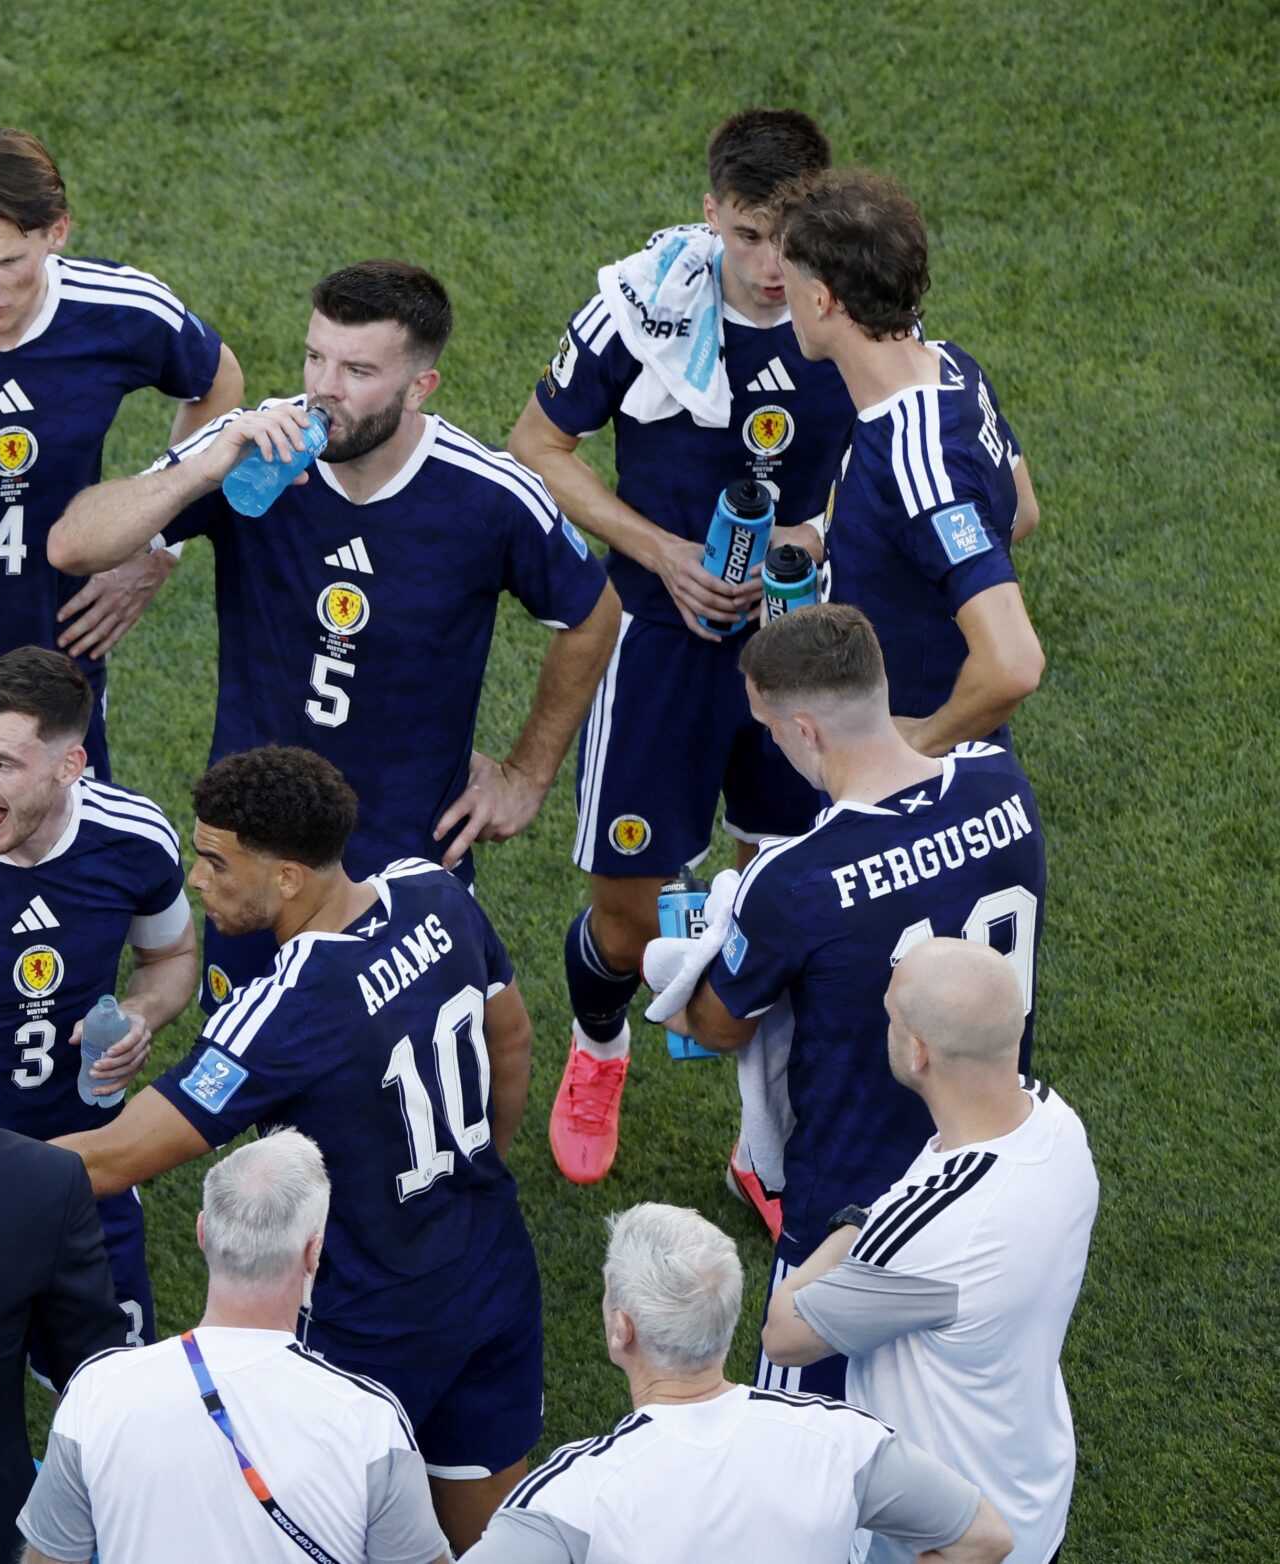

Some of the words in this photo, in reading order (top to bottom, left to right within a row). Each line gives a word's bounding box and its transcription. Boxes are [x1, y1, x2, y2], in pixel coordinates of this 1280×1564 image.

[305, 654, 356, 728] 5
[831, 794, 1033, 909] FERGUSON
[689, 909, 707, 939] DE
[356, 913, 453, 1016] ADAMS
[11, 1020, 57, 1089] 3
[381, 984, 491, 1204] 10
[271, 1508, 300, 1536] 2026
[295, 1535, 313, 1550] CUP
[310, 1547, 335, 1564] ORLD
